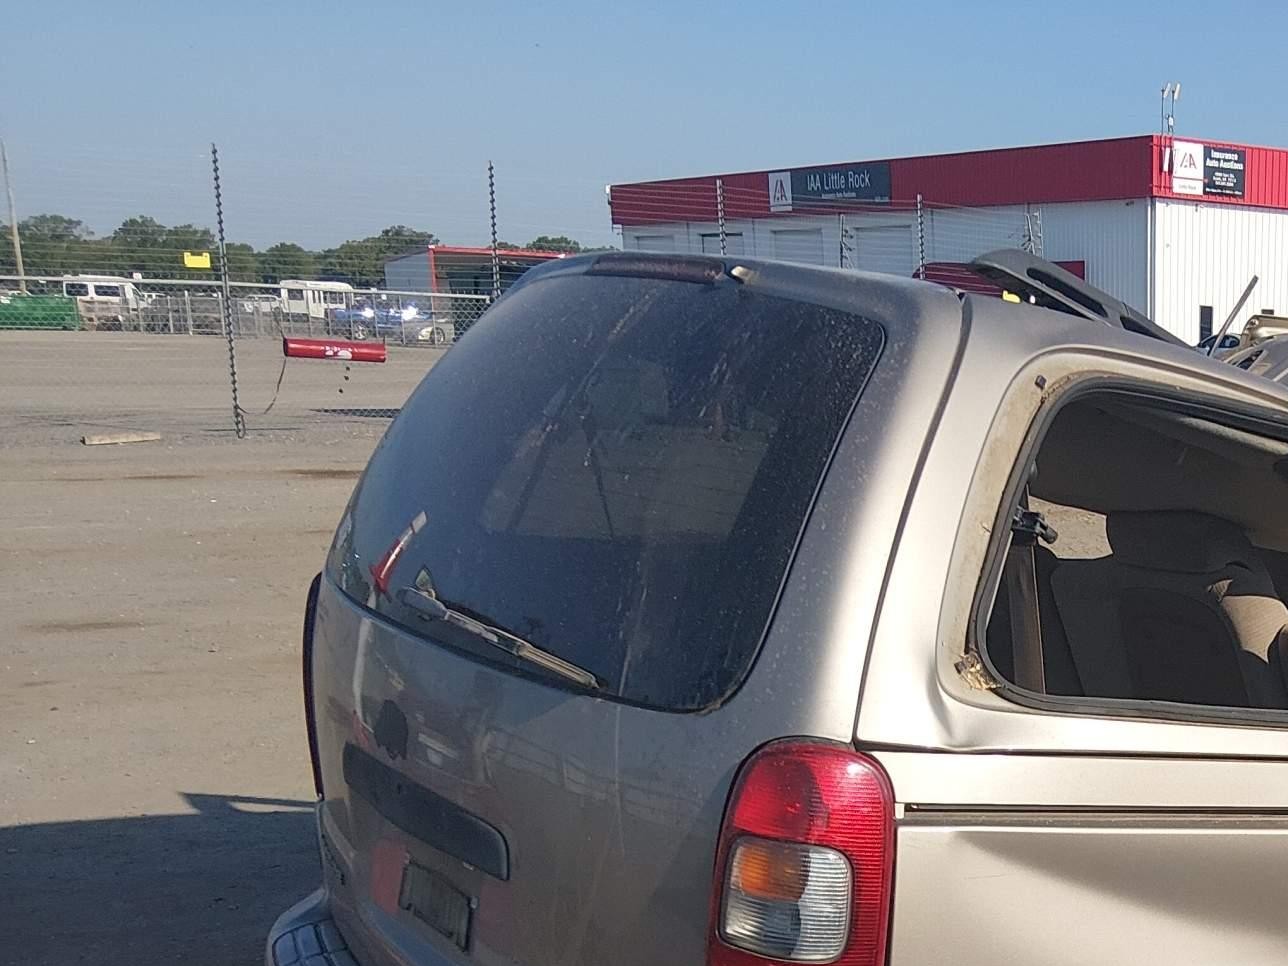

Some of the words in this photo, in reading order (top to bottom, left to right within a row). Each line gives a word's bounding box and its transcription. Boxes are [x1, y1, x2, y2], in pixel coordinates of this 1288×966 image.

[807, 174, 821, 191] IAA
[823, 172, 846, 190] Little
[848, 170, 871, 189] Rock
